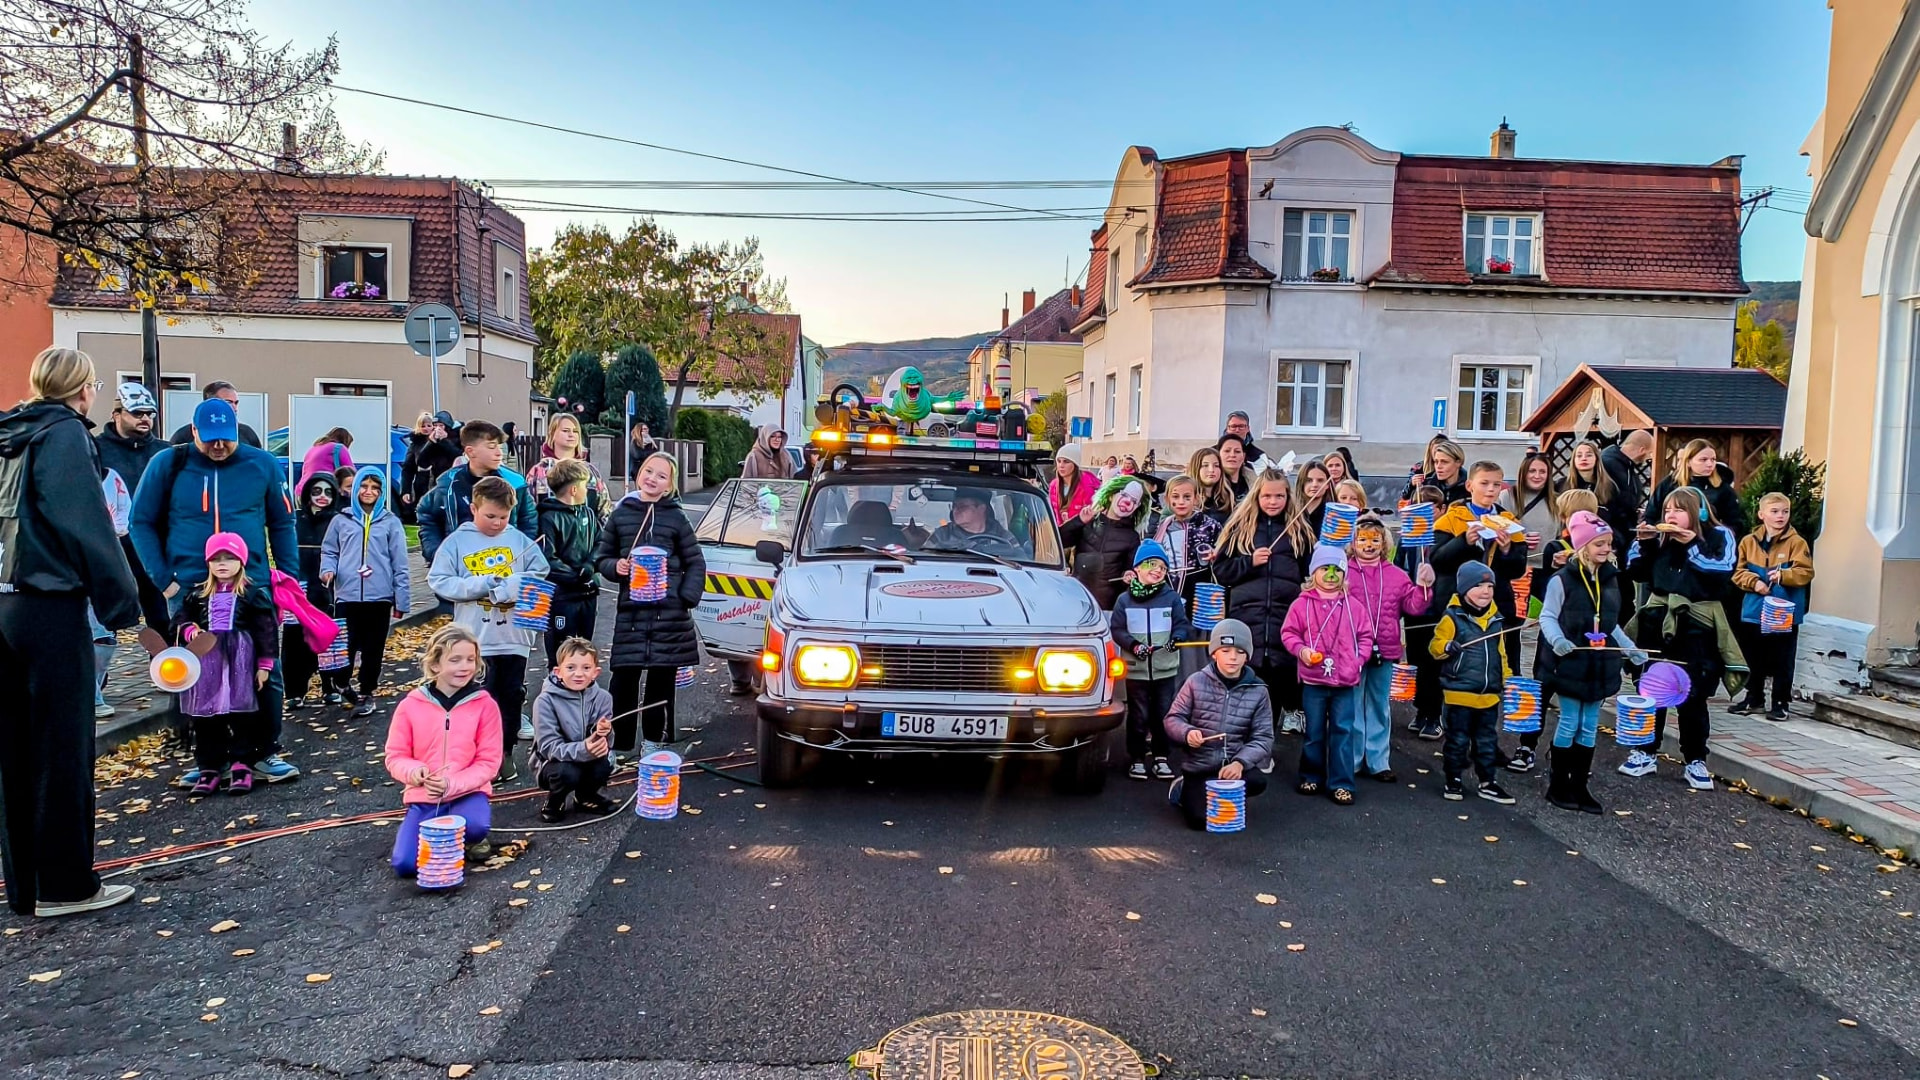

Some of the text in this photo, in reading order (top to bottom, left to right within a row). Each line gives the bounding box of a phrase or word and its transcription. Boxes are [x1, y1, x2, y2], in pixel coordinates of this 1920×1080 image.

[716, 601, 762, 622] nostalgie
[899, 715, 999, 736] 5U8 4591
